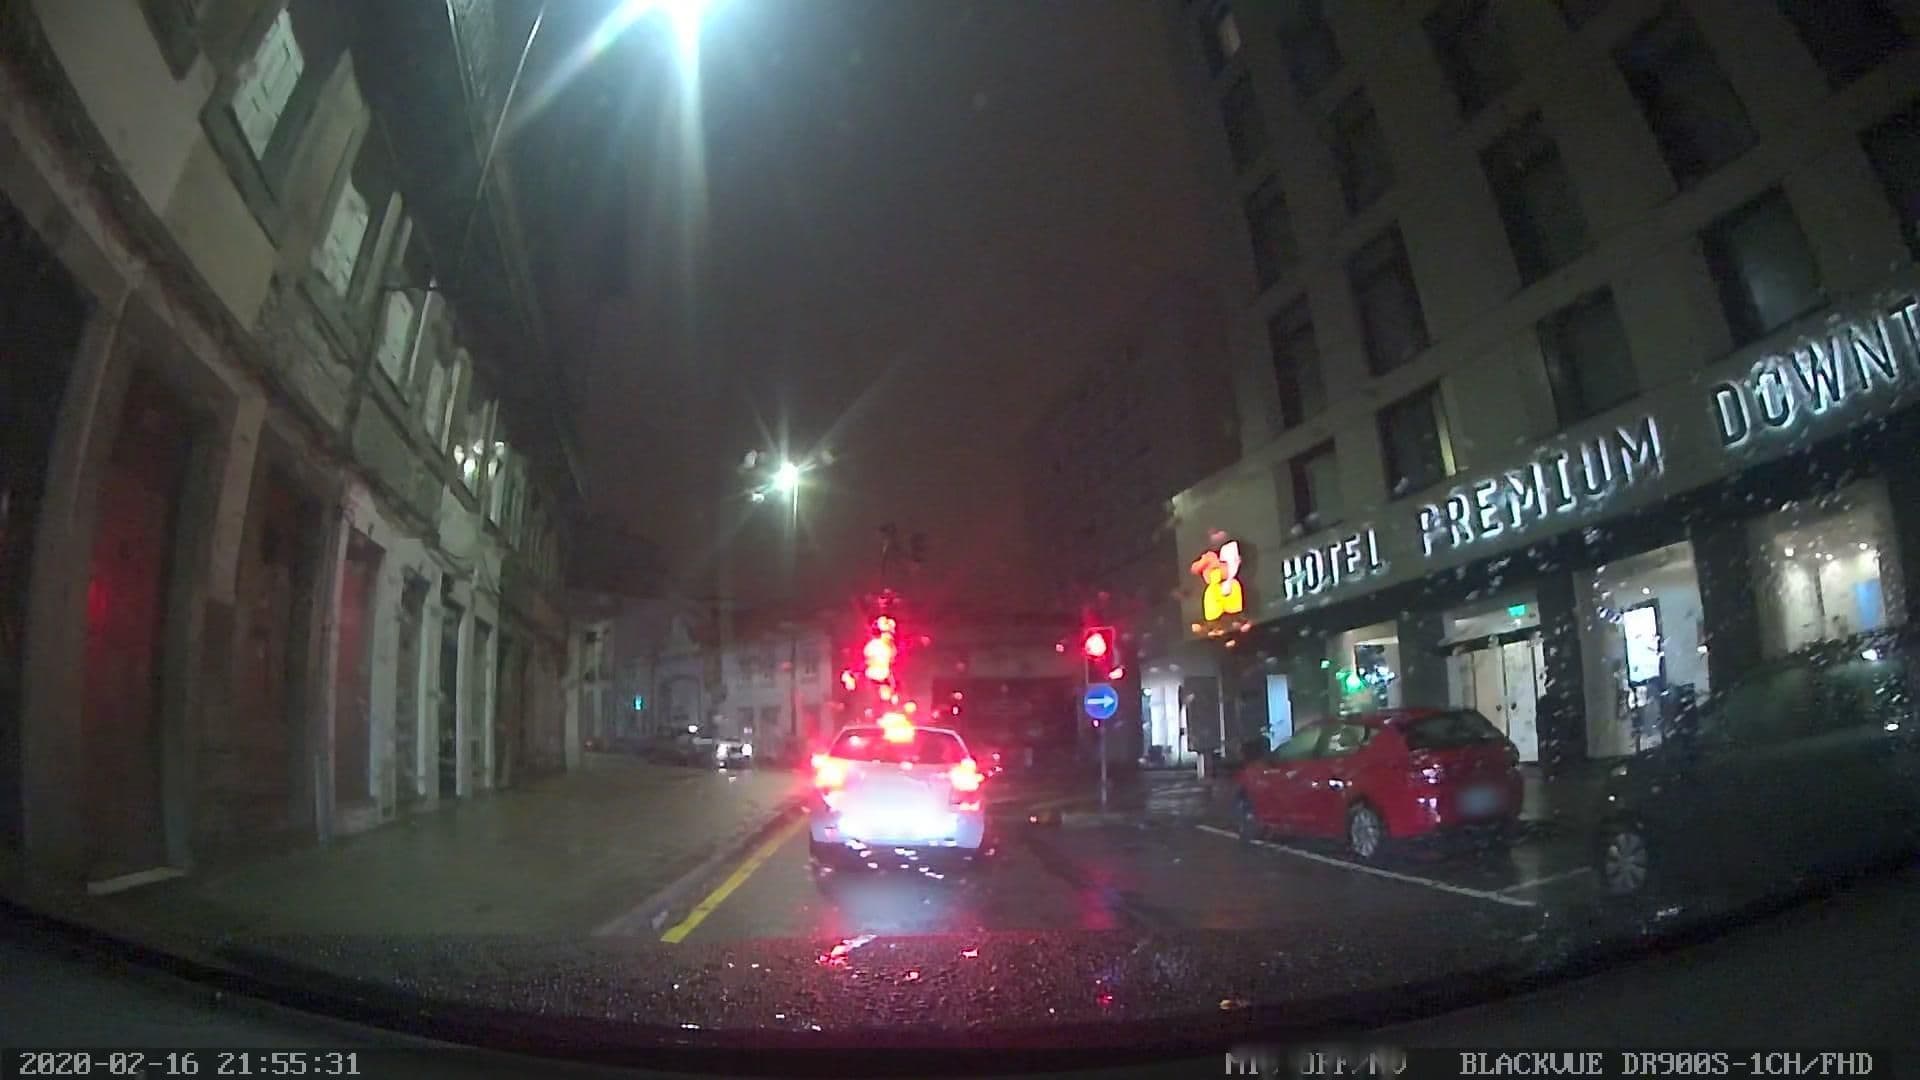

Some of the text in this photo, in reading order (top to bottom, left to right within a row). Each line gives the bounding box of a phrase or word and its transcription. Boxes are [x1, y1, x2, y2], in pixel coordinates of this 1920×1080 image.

[1281, 296, 1920, 601] HOTEL PREMIUM DOWNT
